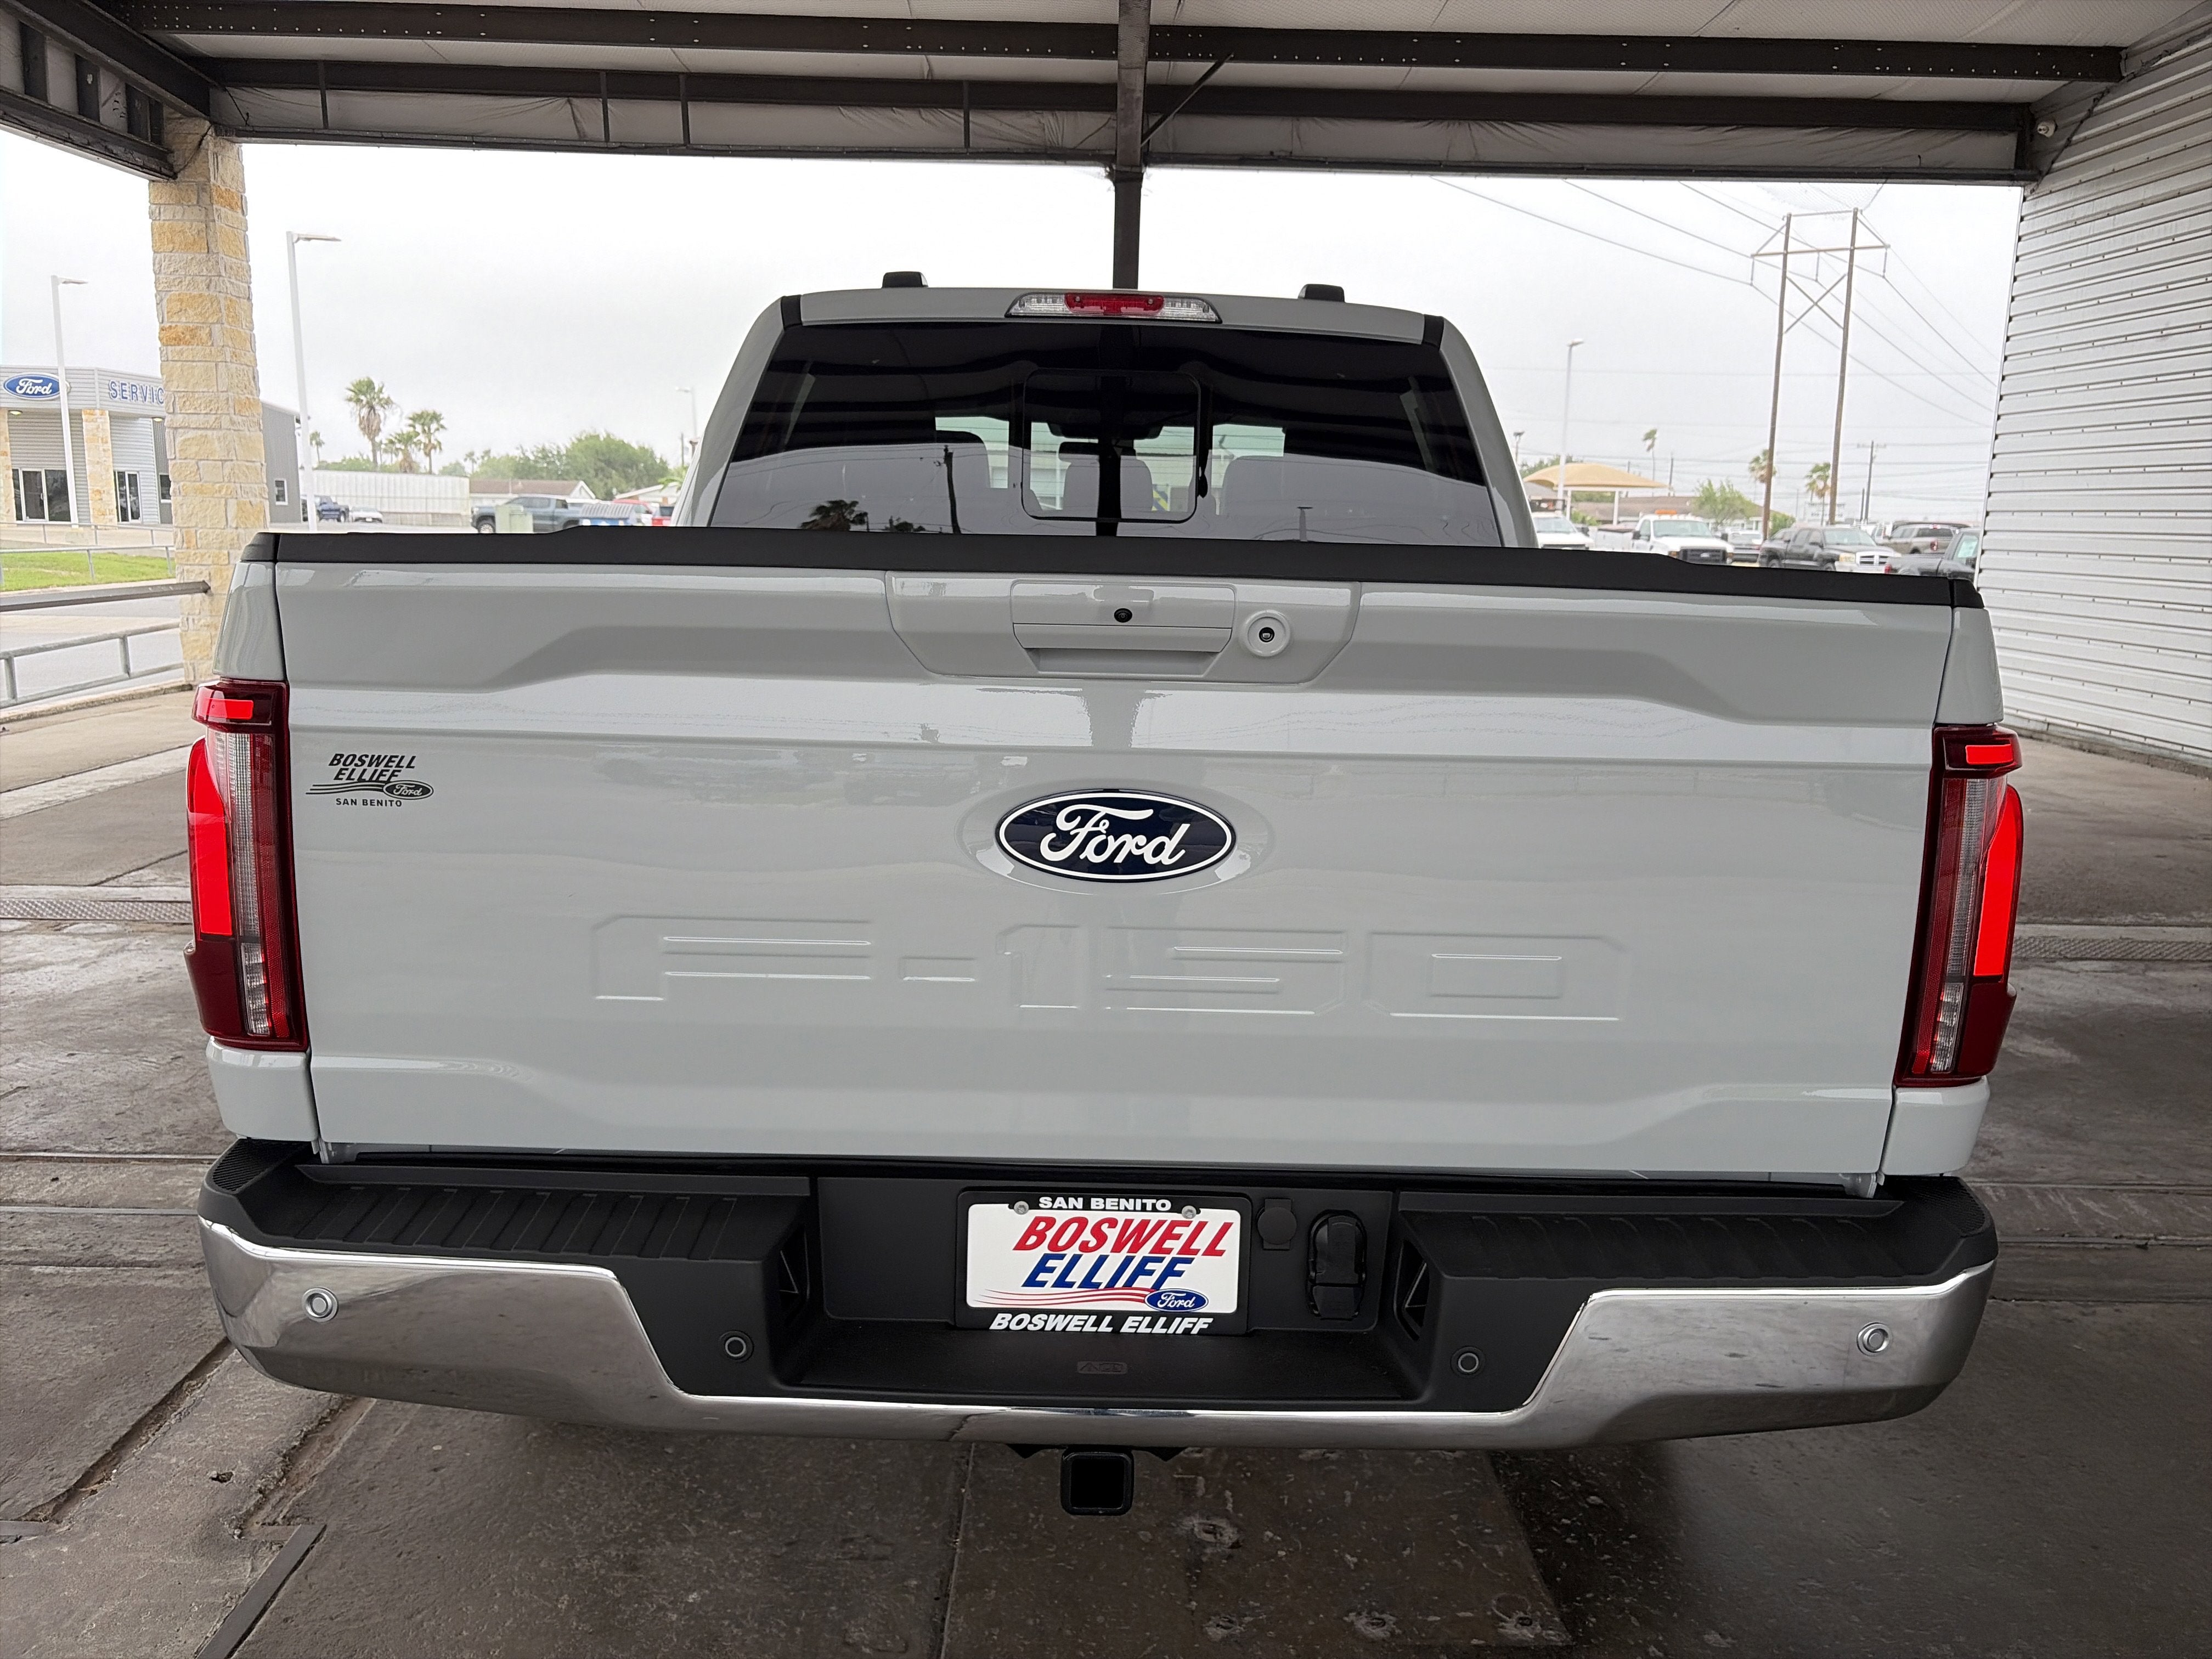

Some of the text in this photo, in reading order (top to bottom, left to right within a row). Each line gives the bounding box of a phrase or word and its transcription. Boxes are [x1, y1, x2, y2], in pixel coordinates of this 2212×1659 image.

[16, 378, 52, 394] Ford
[329, 753, 416, 769] BOSWELL
[334, 768, 402, 782] ELLIFF
[393, 784, 422, 796] Ford
[336, 798, 402, 807] SAN BENITO
[1040, 804, 1191, 866] Ford
[1039, 1197, 1172, 1211] SAN BENITO
[1012, 1216, 1234, 1257] BOSWELL
[1021, 1254, 1195, 1290] ELLIFF
[1157, 1293, 1195, 1309] Ford
[989, 1313, 1214, 1334] BOSWELL ELLIFF
